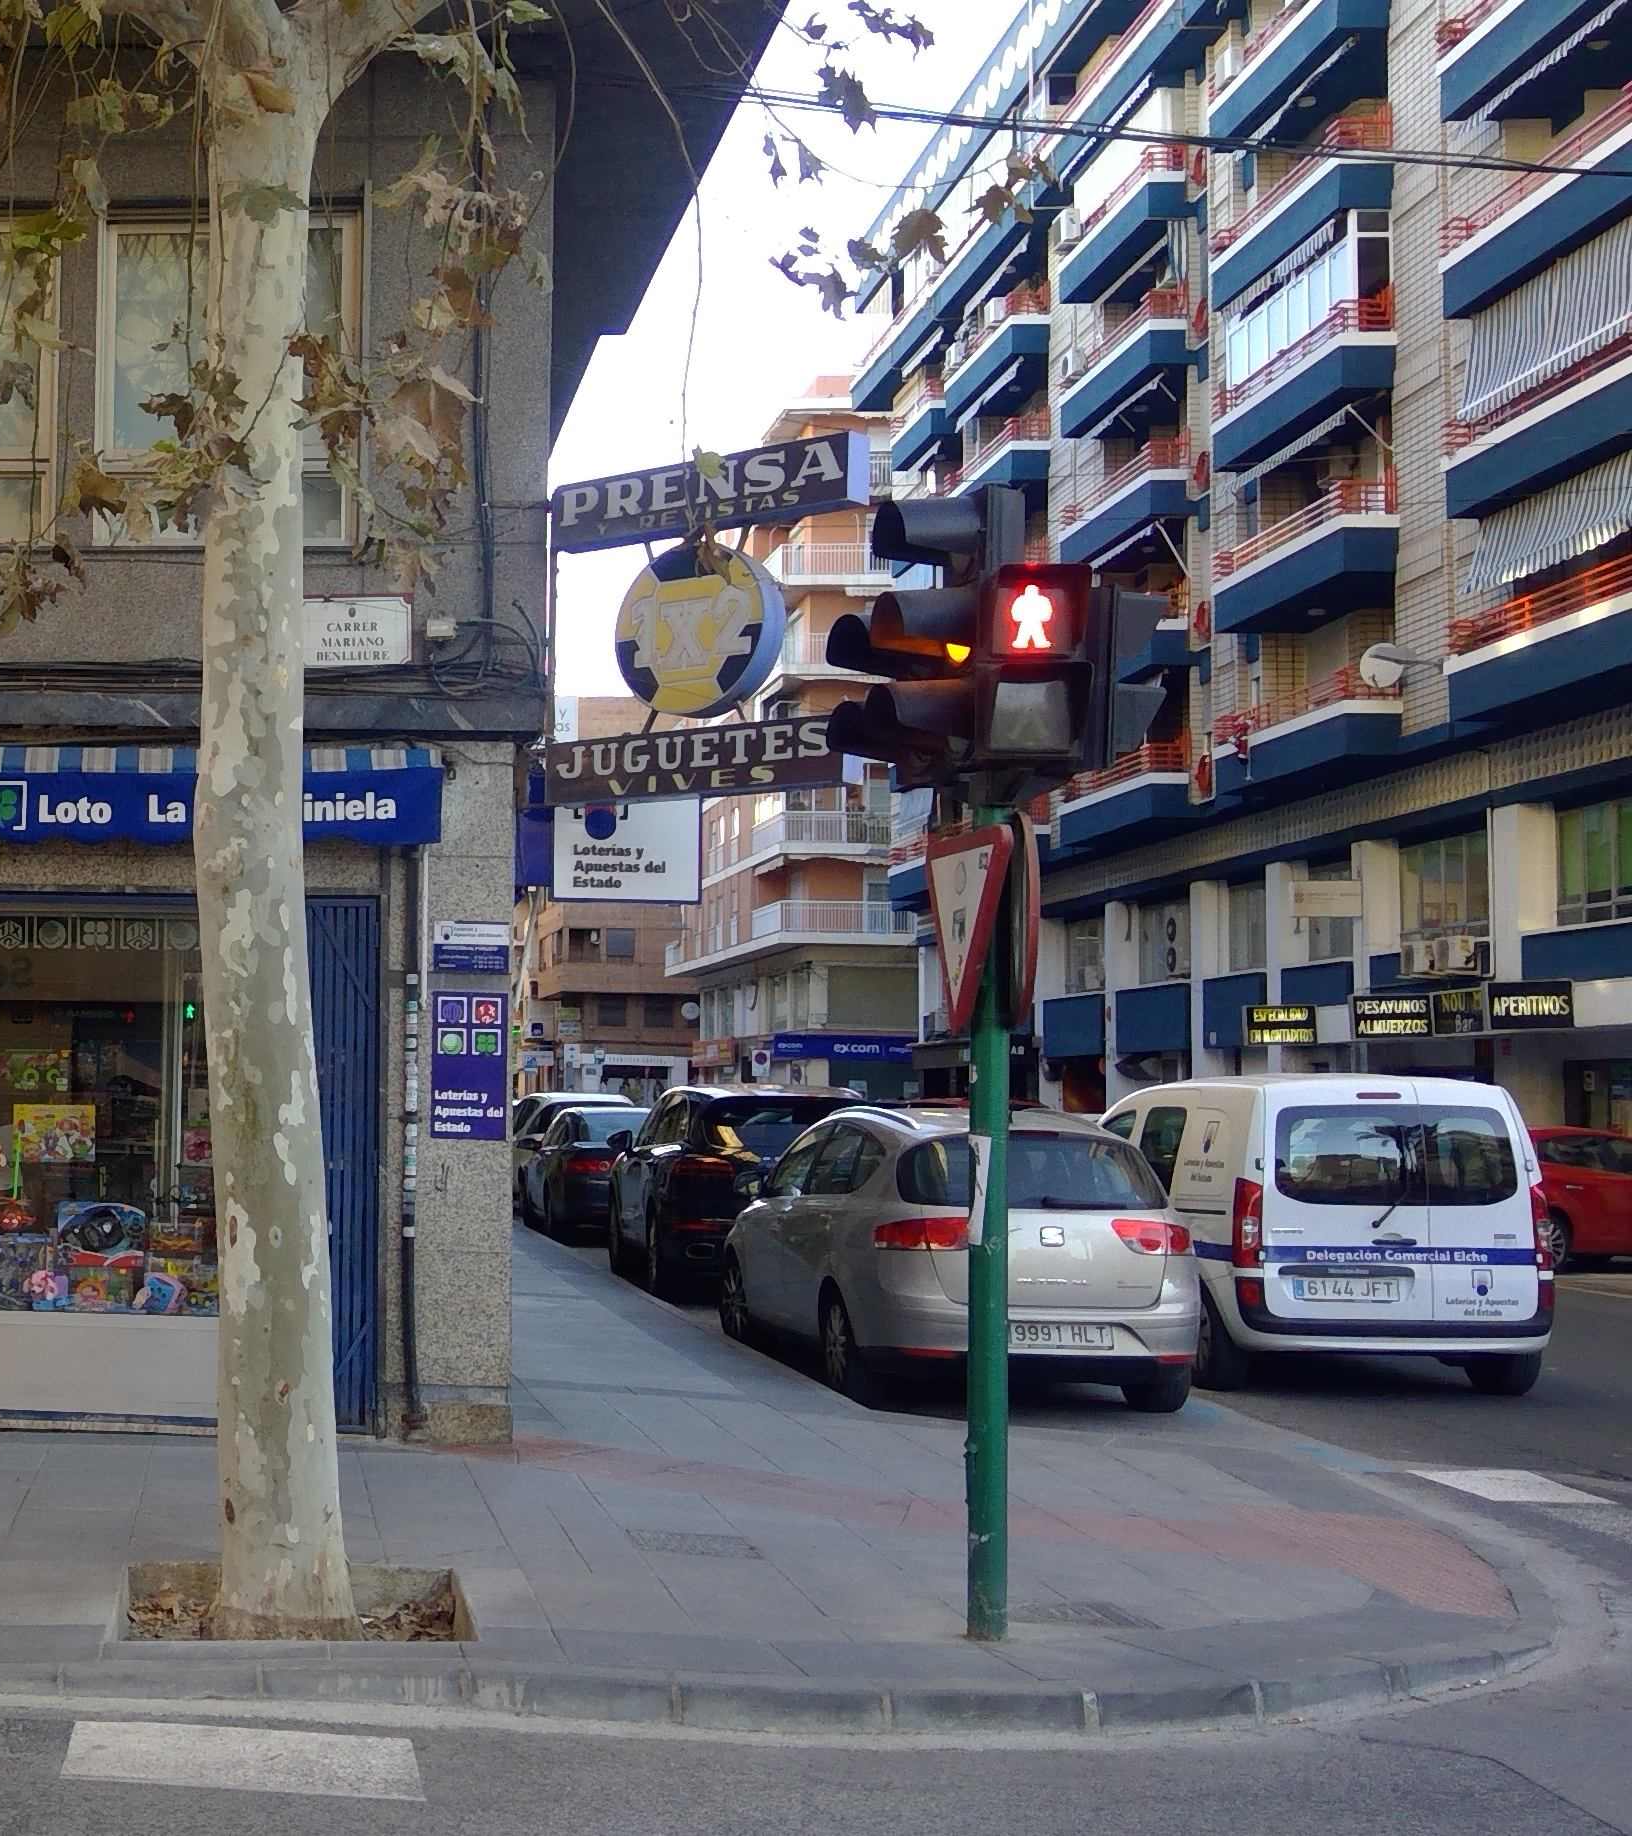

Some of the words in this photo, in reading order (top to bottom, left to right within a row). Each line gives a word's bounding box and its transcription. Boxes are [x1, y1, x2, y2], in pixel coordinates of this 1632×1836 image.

[559, 440, 845, 528] PRENSA
[639, 490, 801, 530] REVISTAS
[326, 621, 378, 633] CARRER
[320, 636, 385, 648] MARIANO
[556, 720, 831, 780] JUGUETES
[608, 765, 776, 797] VIVES
[38, 794, 112, 824] Loto
[148, 793, 186, 823] La
[304, 791, 397, 822] iniela
[573, 843, 632, 857] Loterías
[635, 847, 645, 860] y
[574, 860, 641, 875] Apuestas
[644, 860, 667, 874] del
[572, 875, 622, 889] Estado
[1356, 999, 1427, 1015] DESAYUNOS
[1493, 994, 1570, 1017] APERITIVOS
[1357, 1019, 1428, 1035] ALMUERZOS
[1454, 1015, 1474, 1033] Bar
[434, 1105, 484, 1119] Apuestas
[486, 1106, 504, 1118] del
[434, 1121, 471, 1133] Estado
[1306, 1248, 1381, 1263] Delegación
[1385, 1249, 1450, 1262] Comercial
[1454, 1250, 1488, 1262] Elche
[1307, 1279, 1355, 1297] 6144
[1360, 1280, 1394, 1297] JFT
[1014, 1324, 1063, 1343] 9991
[1070, 1325, 1107, 1343] HLT
